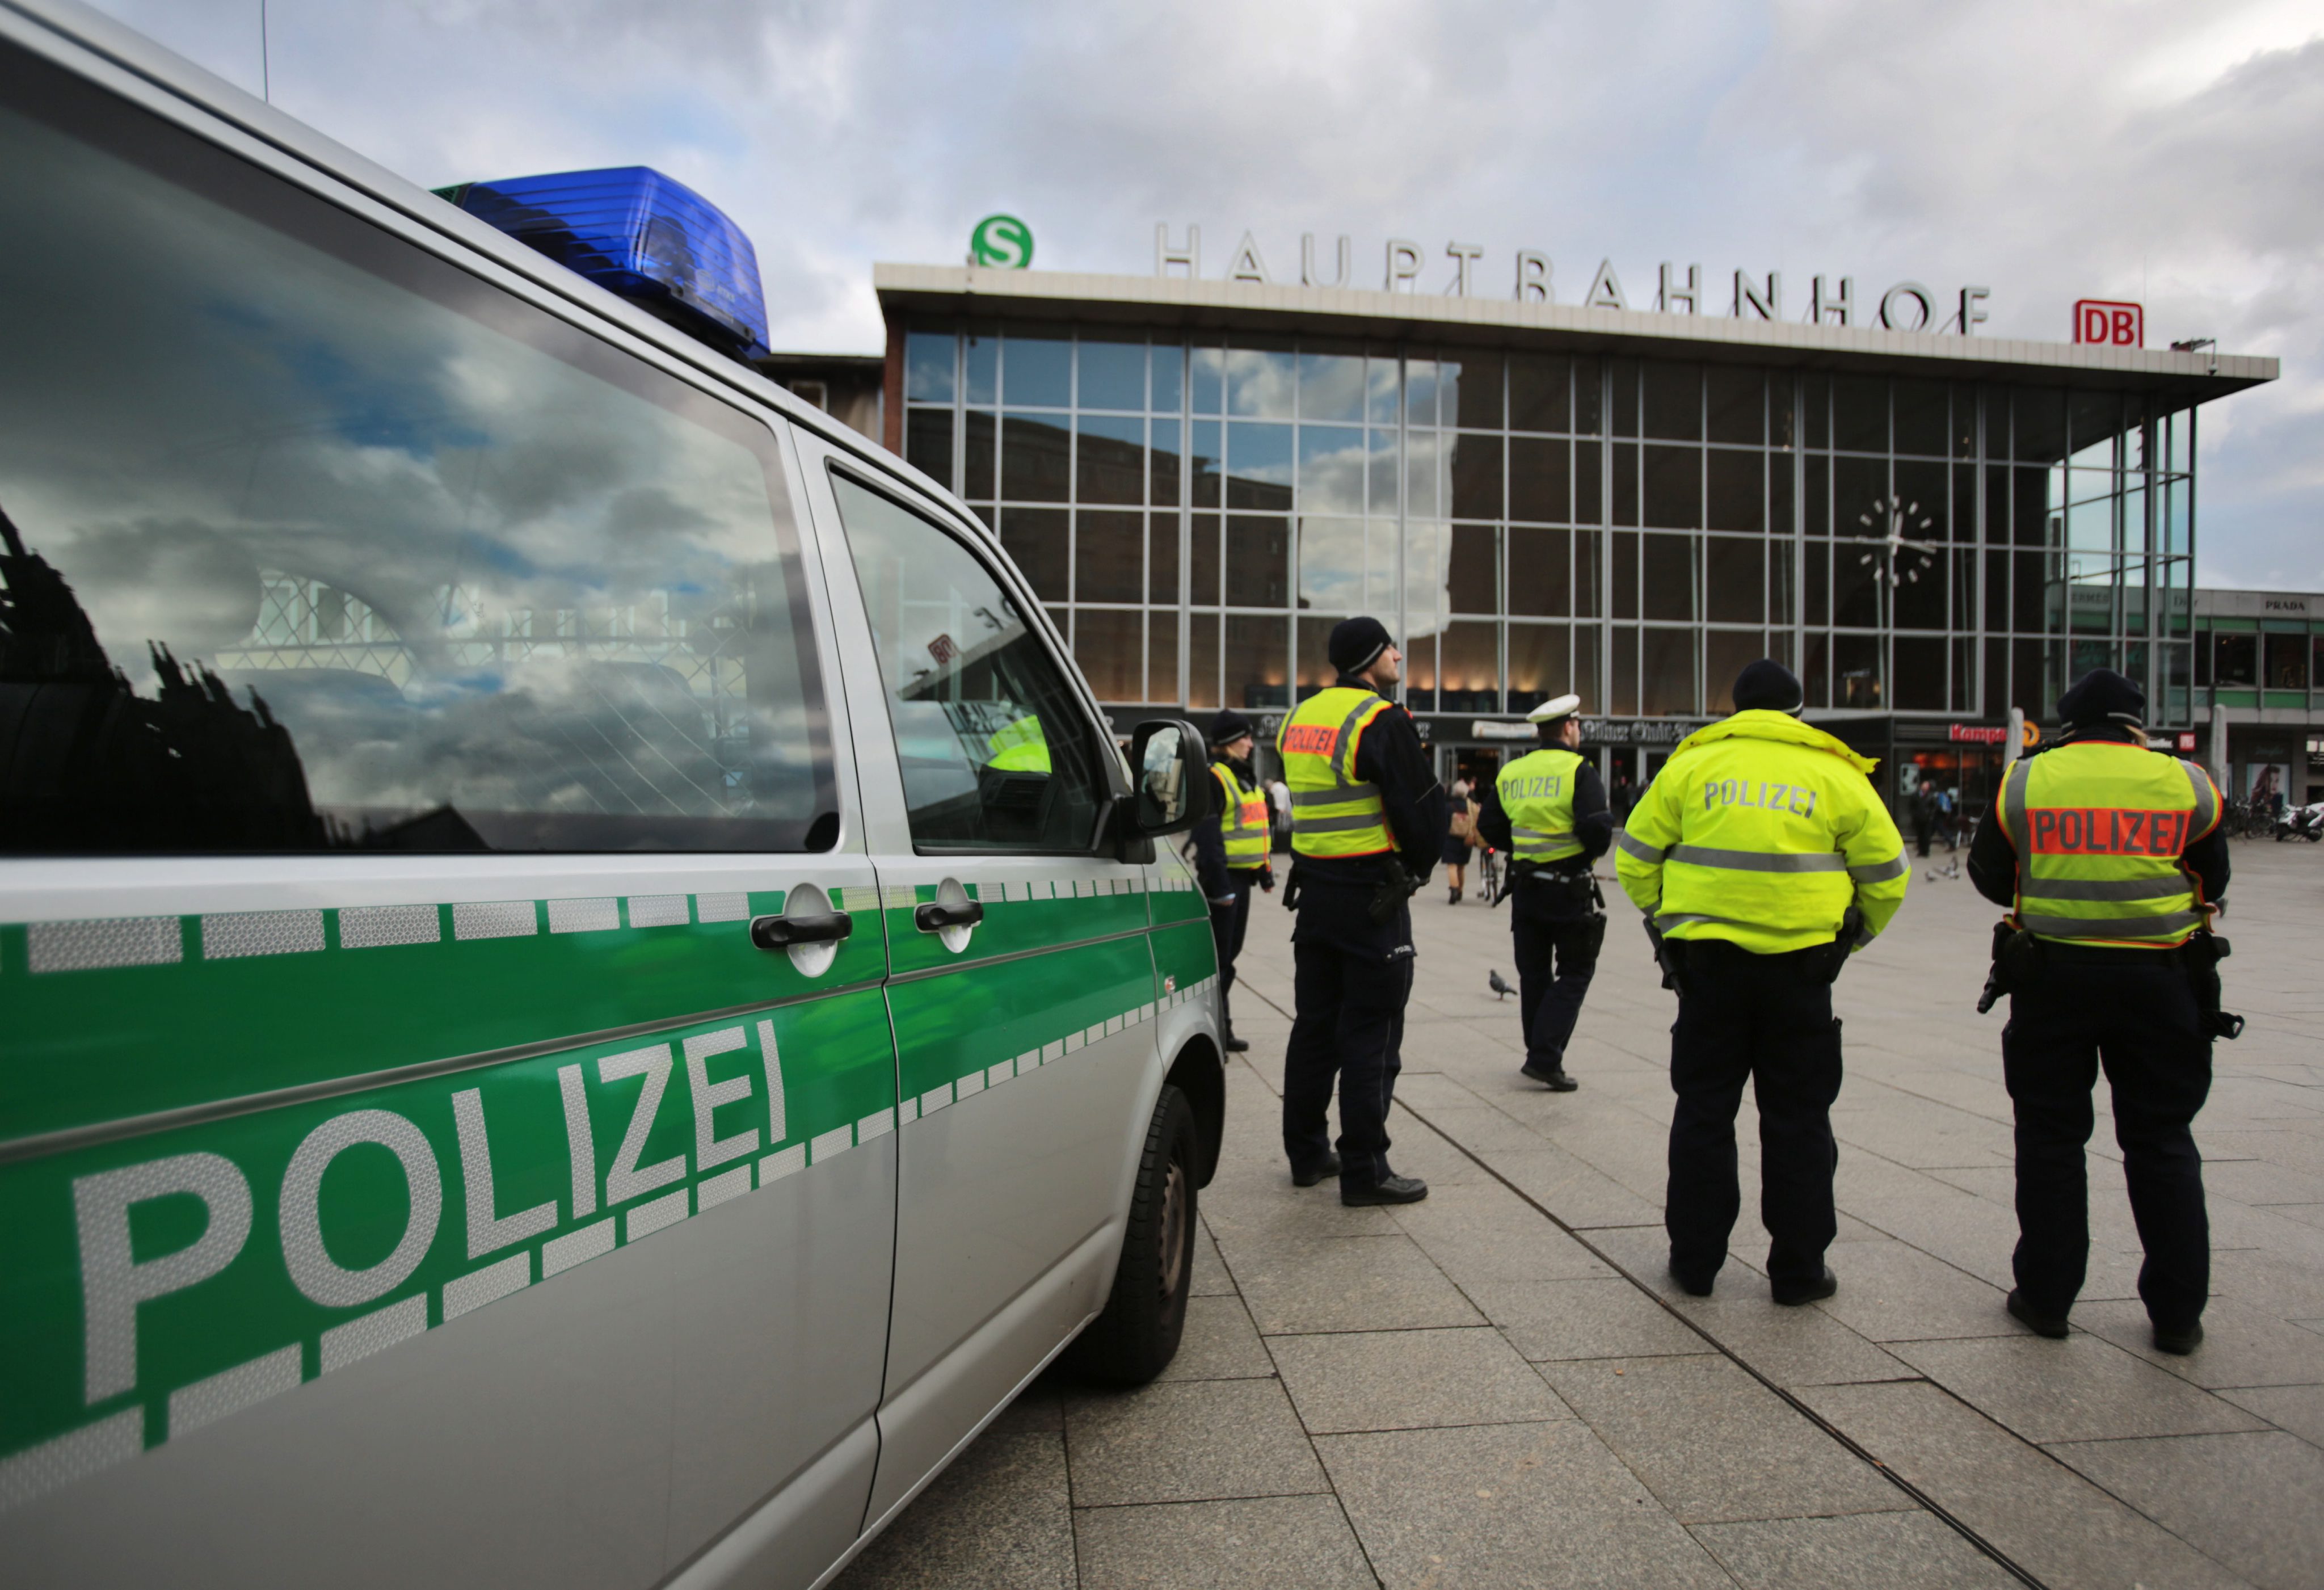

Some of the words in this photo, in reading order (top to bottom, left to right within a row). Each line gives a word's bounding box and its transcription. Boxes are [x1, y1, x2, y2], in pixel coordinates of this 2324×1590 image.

[1155, 222, 1990, 336] HAUPTBAHNHOF
[2084, 307, 2135, 345] DB
[2071, 594, 2110, 604] ERMES
[2173, 595, 2199, 608] Dir
[2265, 600, 2305, 611] PRADA
[1287, 727, 1333, 752] POLIZEI
[1948, 723, 2008, 747] Kamps
[1502, 776, 1561, 801] POLIZEI
[1704, 779, 1817, 819] POLIZEI
[2035, 810, 2185, 855] POLIZEI
[72, 1019, 787, 1406] POLIZEI
